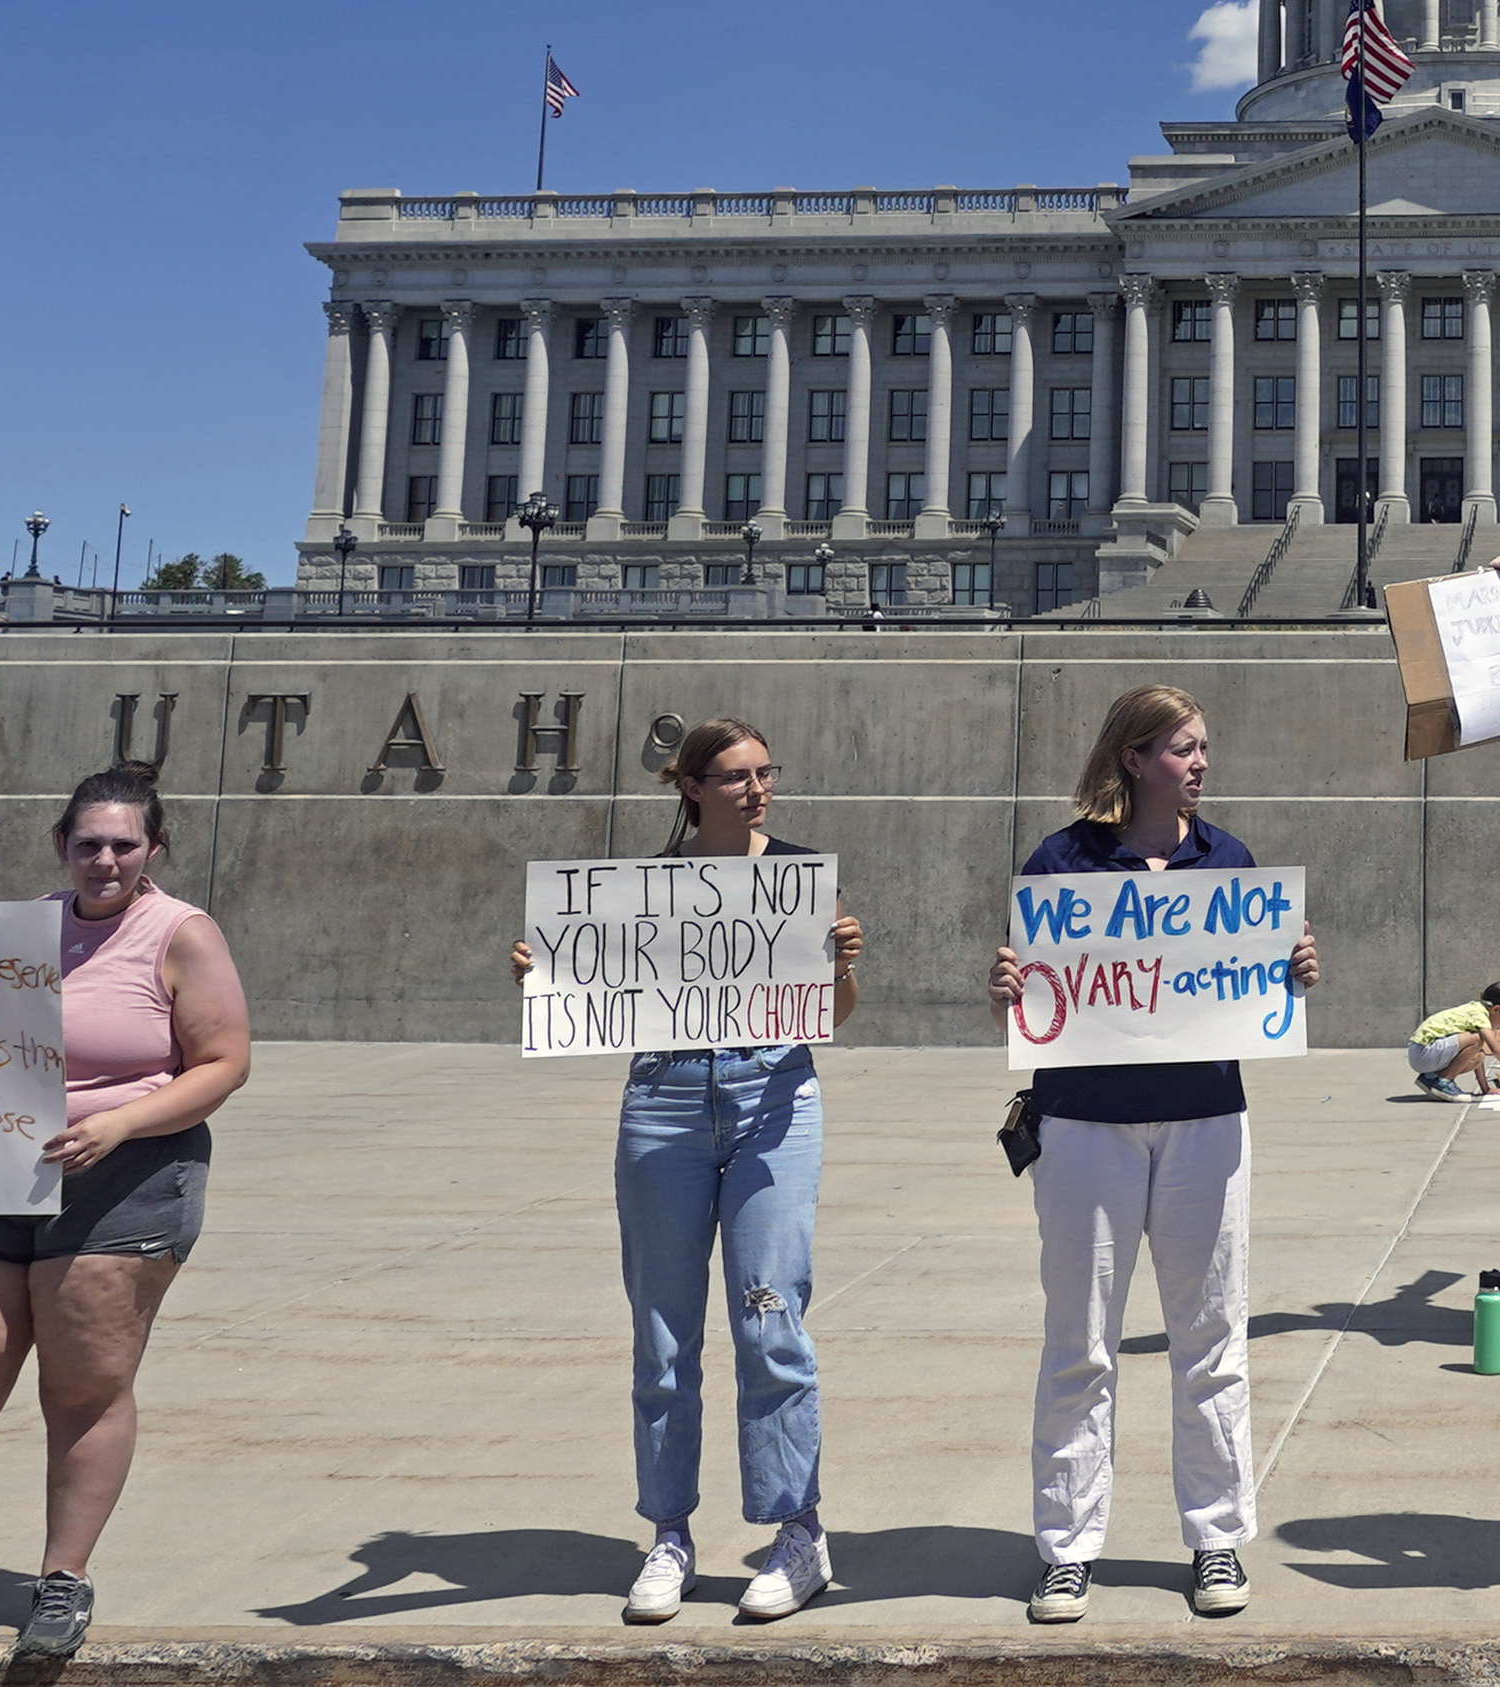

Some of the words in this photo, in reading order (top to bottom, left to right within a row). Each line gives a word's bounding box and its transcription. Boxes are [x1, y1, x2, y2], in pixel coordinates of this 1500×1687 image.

[1427, 241, 1451, 255] OF
[114, 690, 582, 772] UTAH
[556, 867, 618, 915] IF
[634, 861, 723, 918] IT'S
[751, 863, 825, 916] NOT
[1016, 886, 1093, 946] We
[1105, 878, 1192, 940] Are
[536, 921, 658, 989] YOUR
[681, 918, 787, 983] BODY
[523, 991, 576, 1051] IT'S
[586, 989, 643, 1048] NOT
[657, 984, 742, 1044] YOUR
[746, 983, 834, 1041] CHOICE
